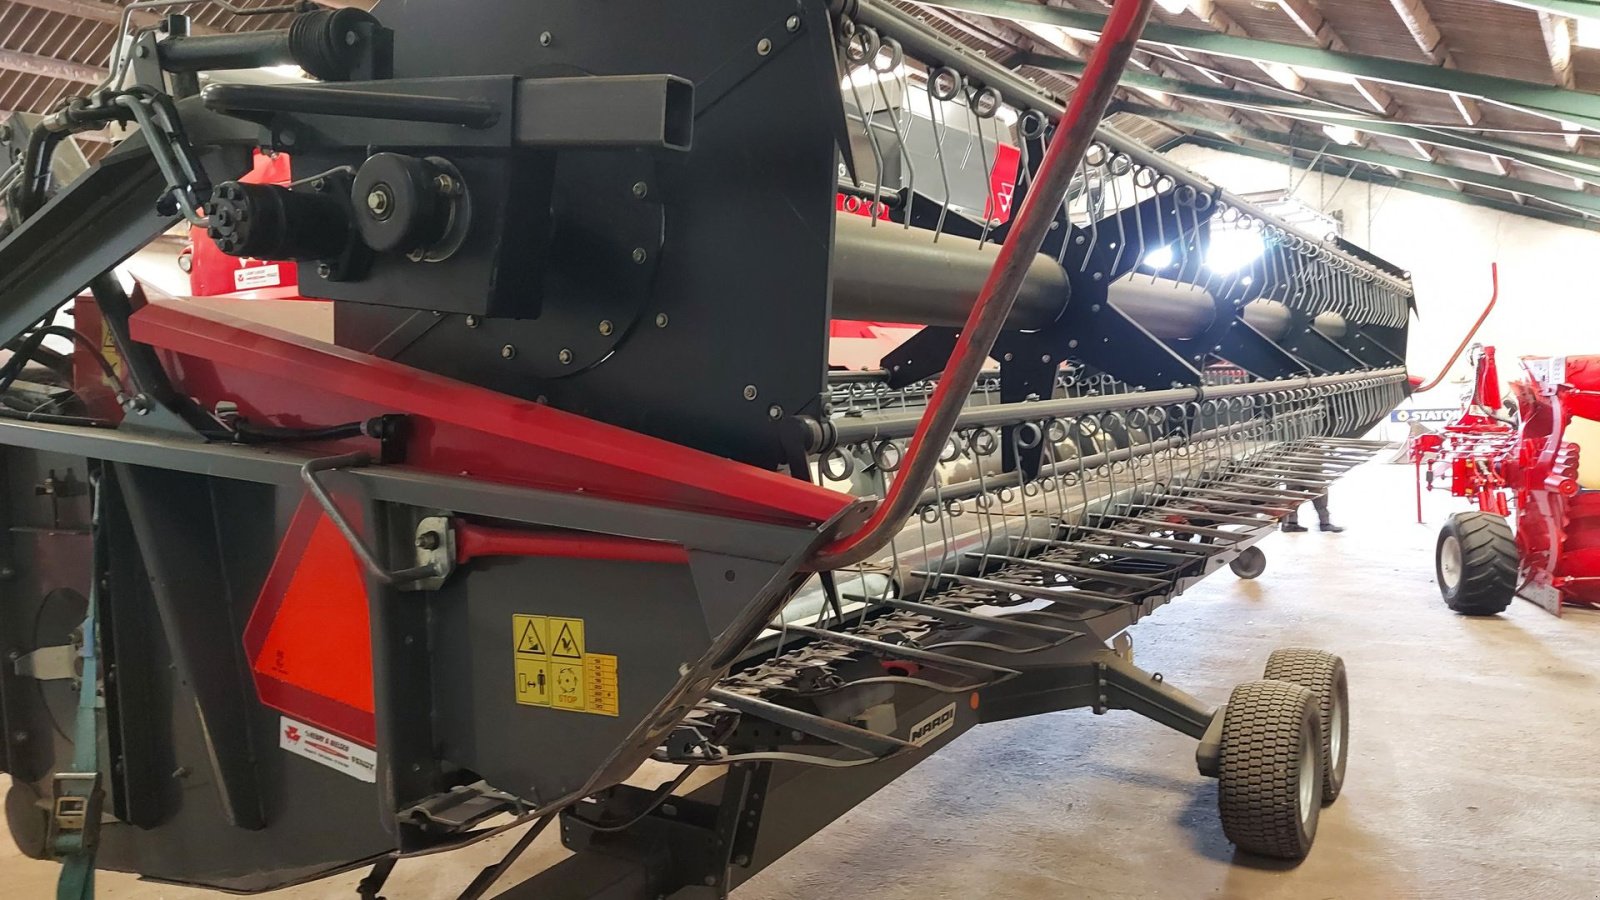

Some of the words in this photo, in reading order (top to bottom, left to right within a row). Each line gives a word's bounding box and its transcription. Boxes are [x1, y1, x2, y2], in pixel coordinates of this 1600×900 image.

[1411, 410, 1461, 421] STATO
[559, 695, 577, 704] STOP
[911, 708, 954, 742] NARDI
